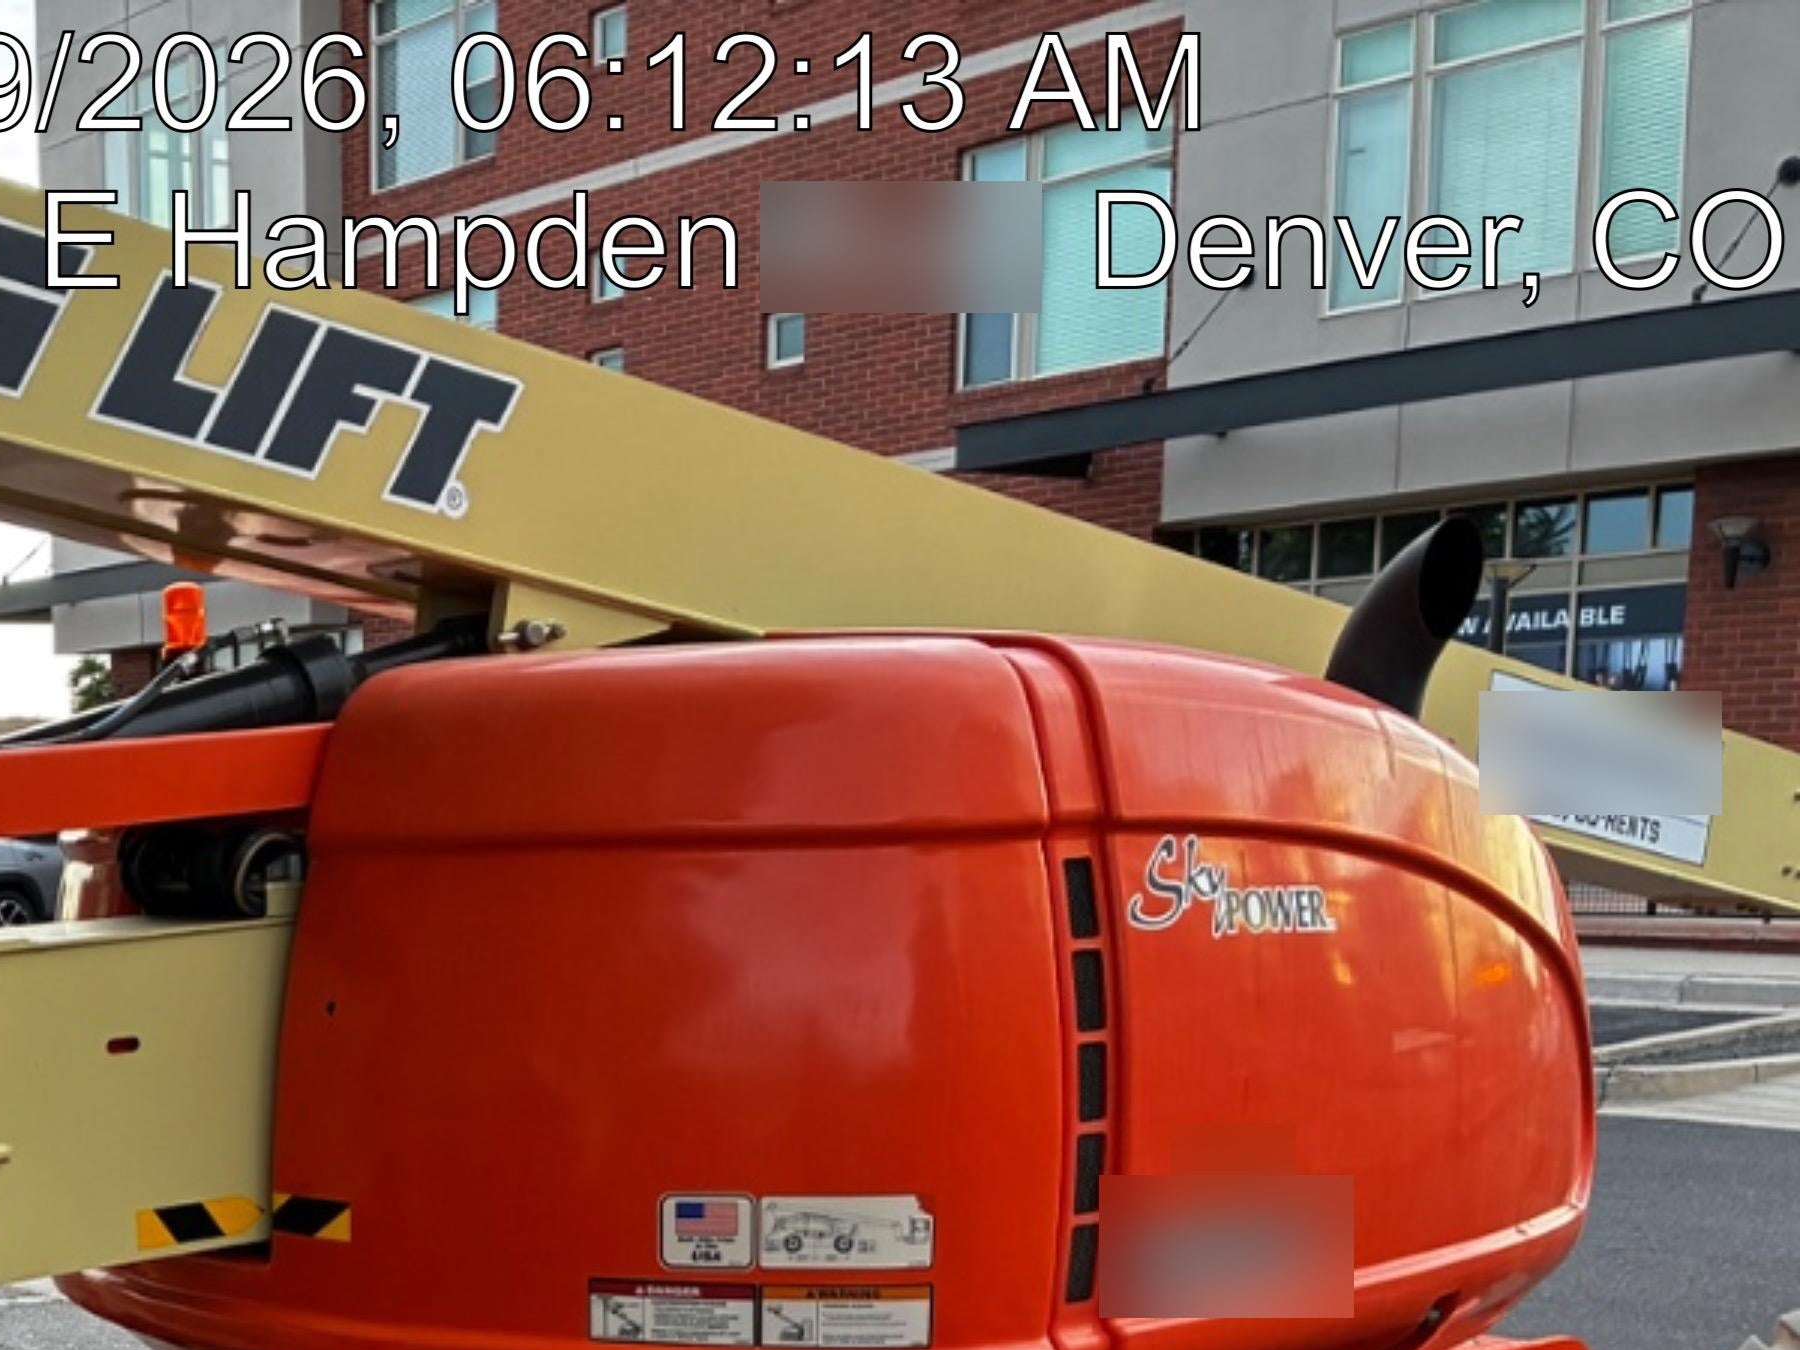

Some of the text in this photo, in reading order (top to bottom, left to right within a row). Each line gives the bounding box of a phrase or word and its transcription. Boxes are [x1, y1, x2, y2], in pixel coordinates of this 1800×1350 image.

[88, 269, 525, 510] LIFT
[1128, 834, 1332, 940] Sky POWER
